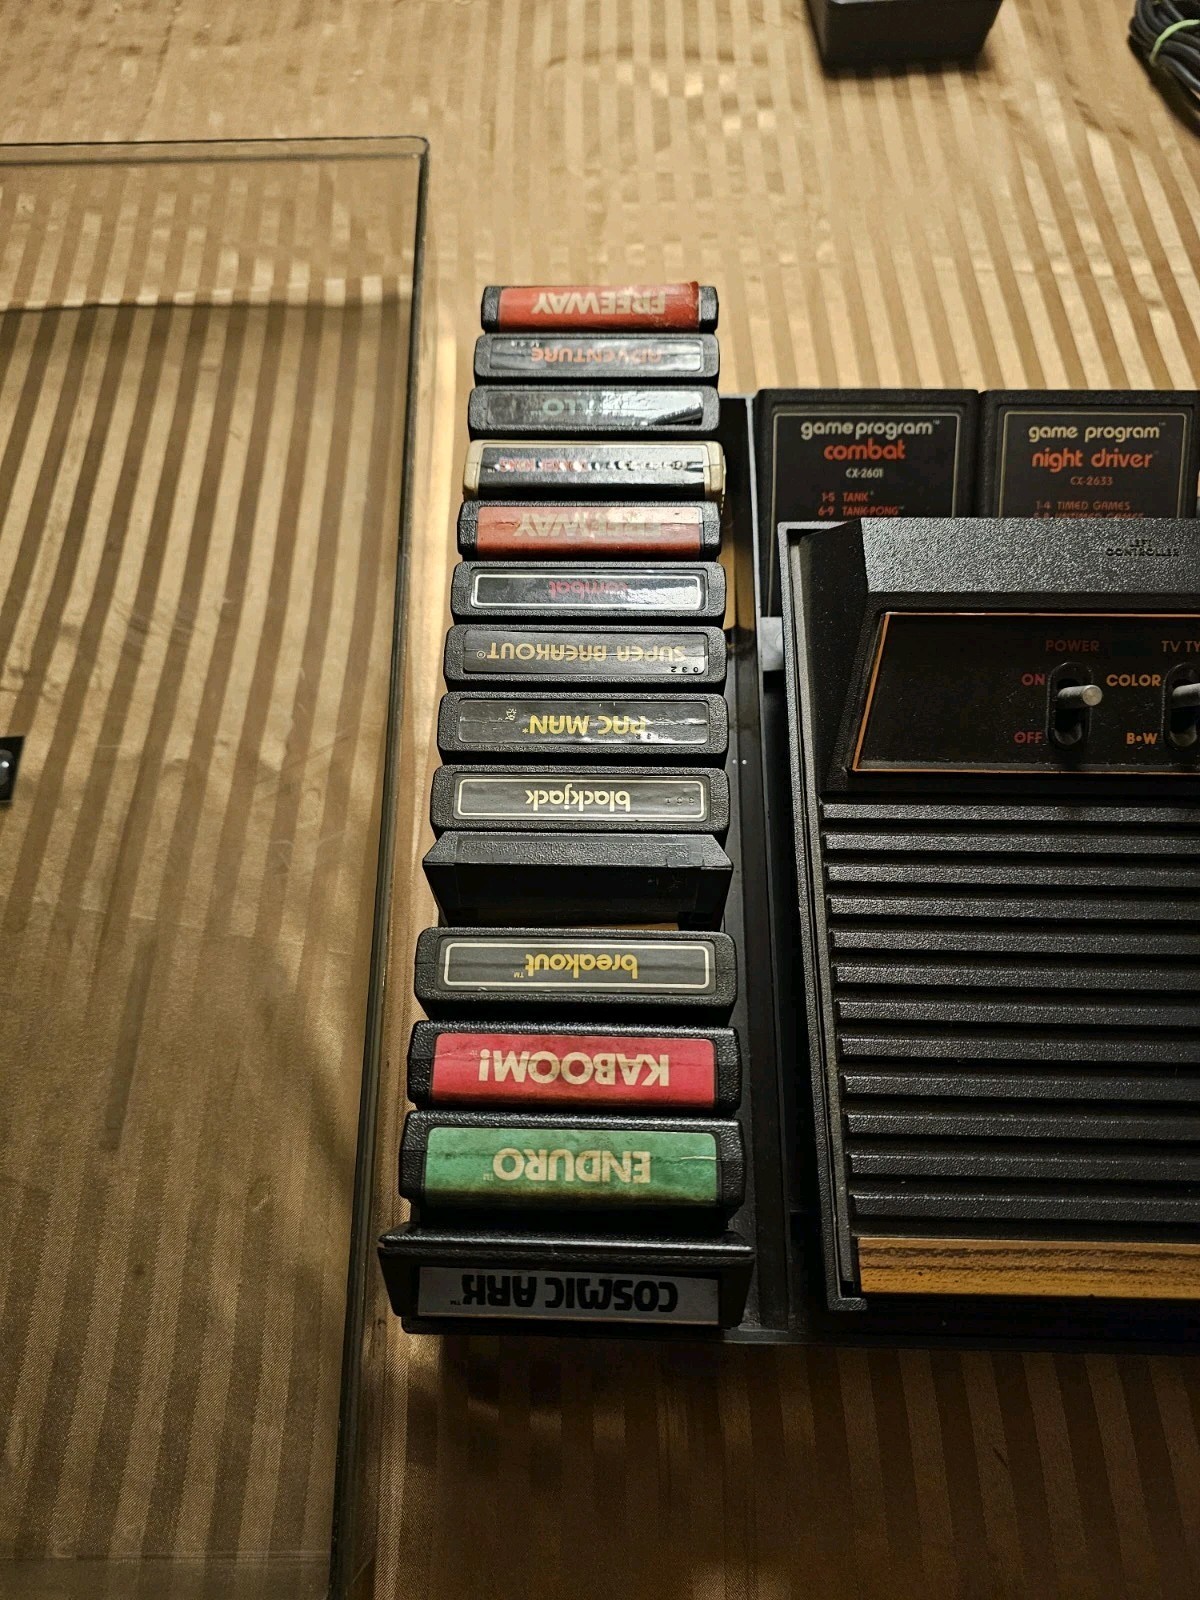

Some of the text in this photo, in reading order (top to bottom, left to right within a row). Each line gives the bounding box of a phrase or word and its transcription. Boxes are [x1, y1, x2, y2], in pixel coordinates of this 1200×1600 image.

[531, 291, 666, 315] FREEWAY
[531, 347, 662, 364] ADVENTURE
[801, 421, 853, 440] game
[1028, 426, 1160, 443] game program
[824, 439, 906, 461] combat
[1032, 447, 1153, 472] night driver
[842, 492, 869, 502] TANK
[1057, 501, 1089, 511] TIMED
[1092, 501, 1131, 511] GAMES
[515, 512, 661, 537] FREEWAY
[550, 579, 628, 598] combat
[617, 646, 686, 662] SUPER
[1046, 640, 1099, 651] POWER
[1161, 640, 1183, 652] TV
[1021, 674, 1045, 686] ON
[1106, 674, 1161, 687] COLOR
[598, 716, 646, 735] PAC
[1014, 731, 1043, 744] OFF
[525, 784, 631, 812] blackjack
[478, 1048, 670, 1087] KABOOM!
[545, 1276, 678, 1313] COSMIC
